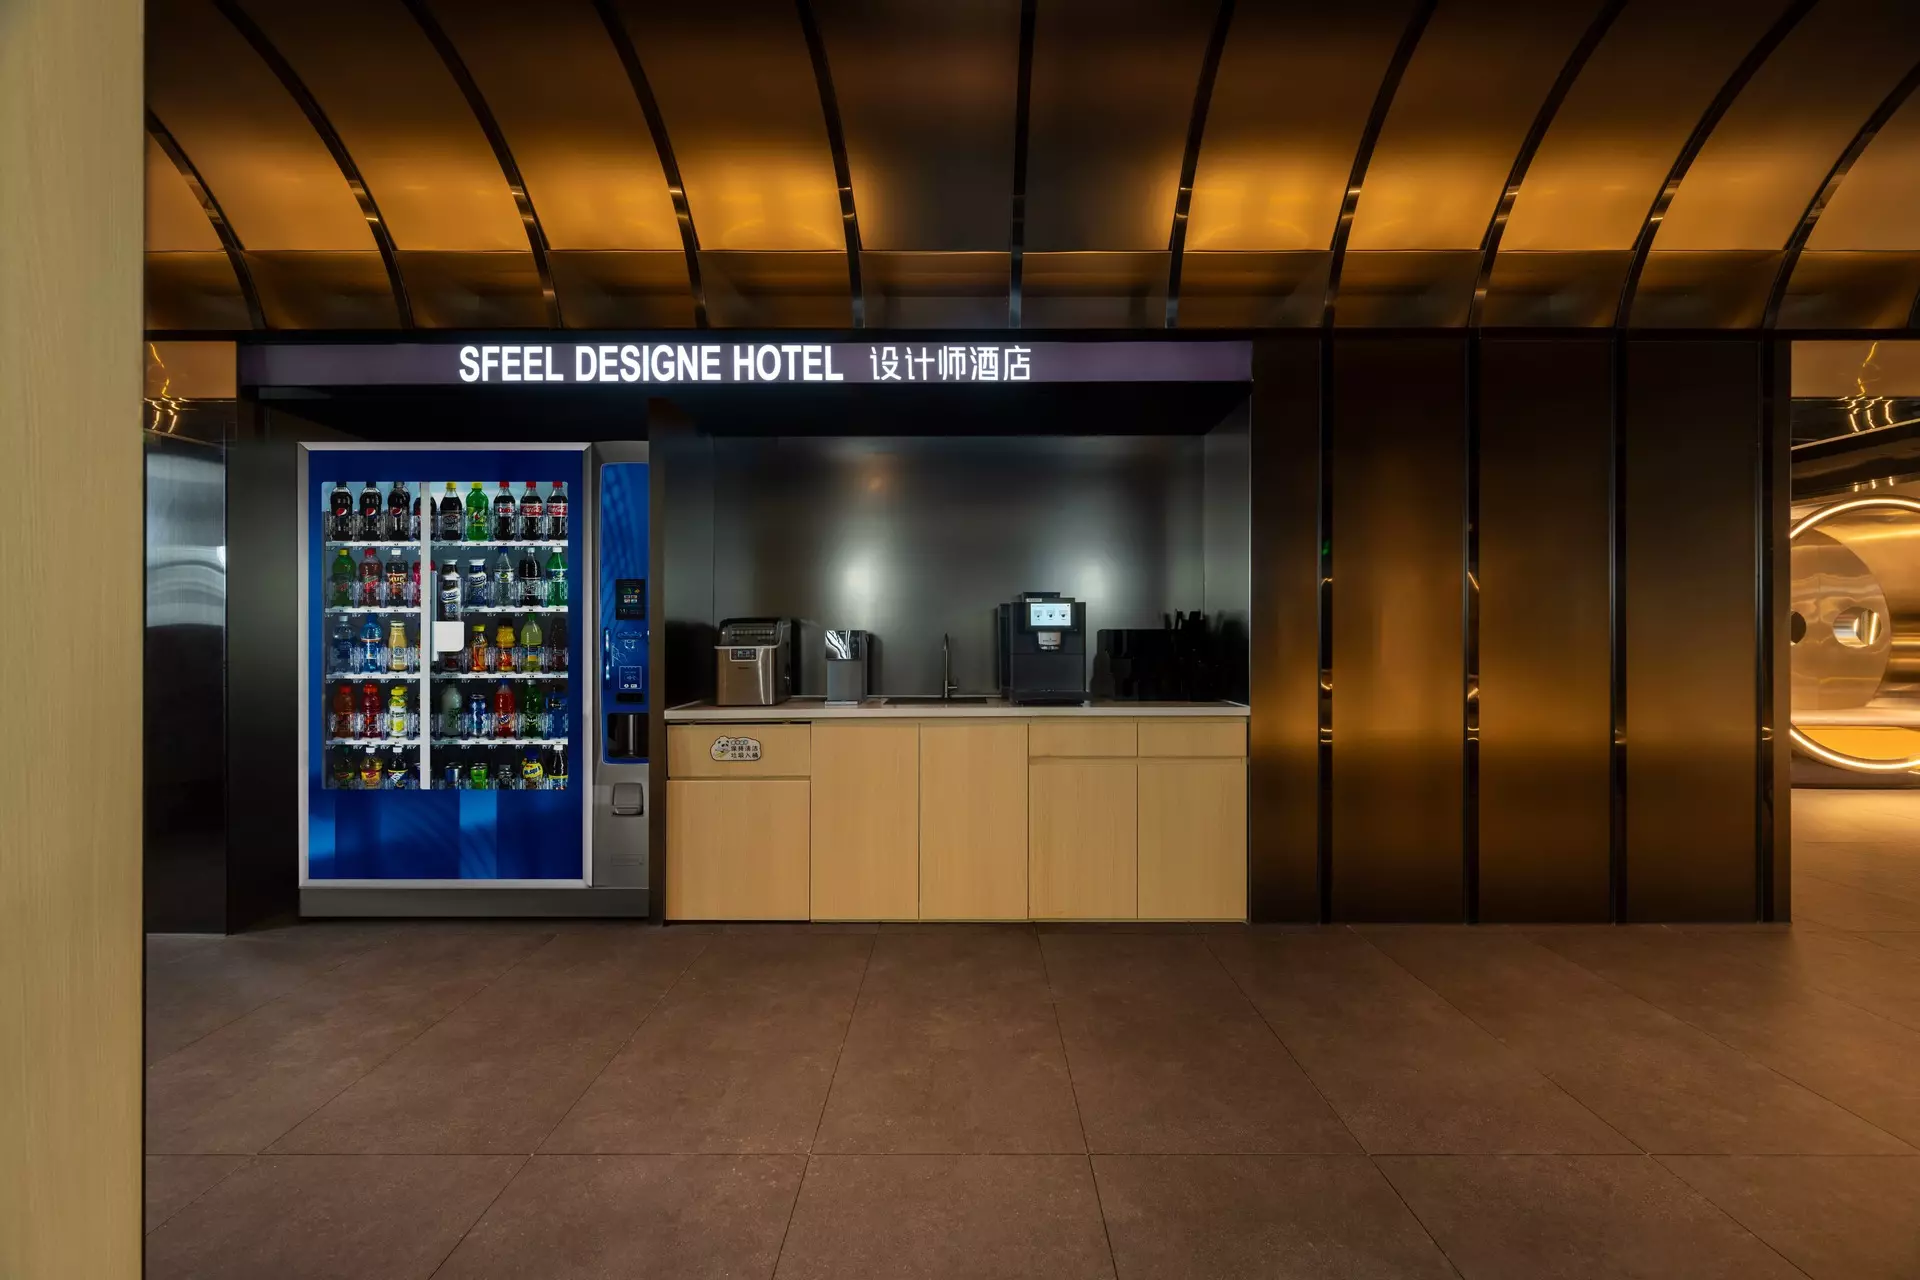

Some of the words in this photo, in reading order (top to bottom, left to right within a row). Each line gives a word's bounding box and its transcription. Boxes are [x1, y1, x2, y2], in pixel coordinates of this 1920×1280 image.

[458, 345, 563, 382] SFEEL
[575, 345, 721, 382] DESIGNE
[733, 345, 843, 382] HOTEL
[869, 345, 1031, 381] 设计师酒店
